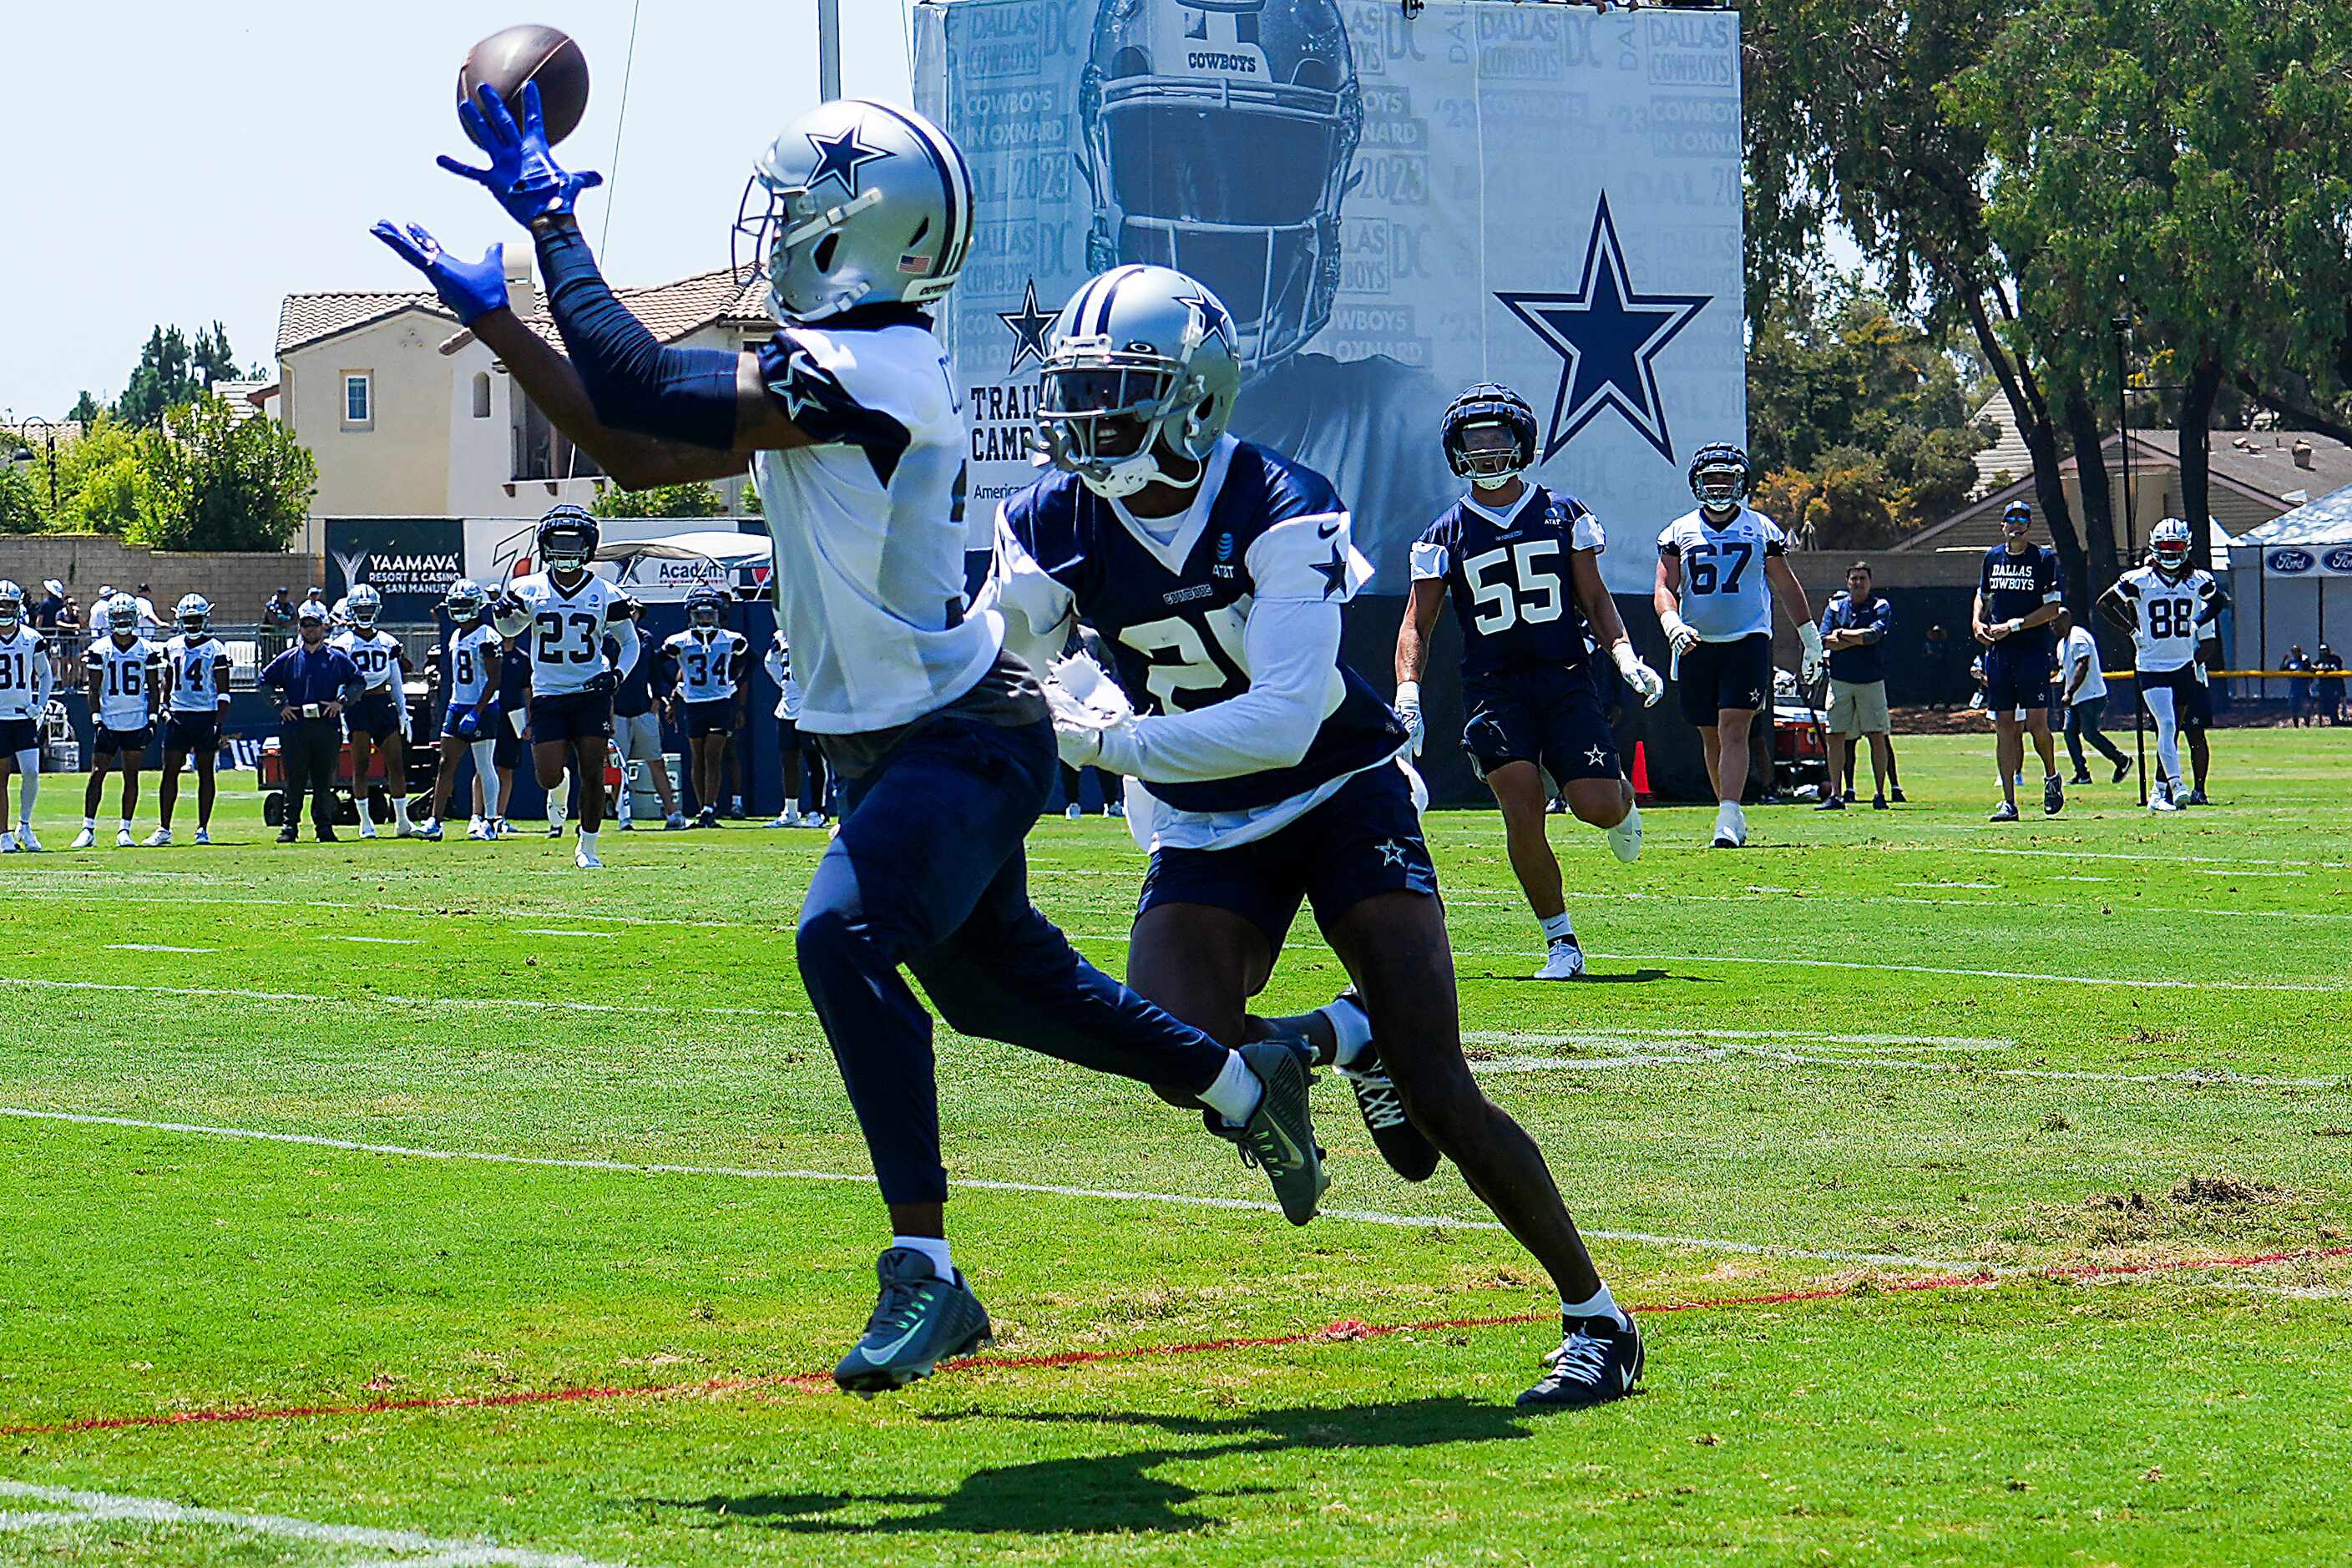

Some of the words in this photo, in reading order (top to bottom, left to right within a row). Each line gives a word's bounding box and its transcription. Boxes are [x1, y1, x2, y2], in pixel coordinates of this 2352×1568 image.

[972, 5, 1040, 39] DALLAS
[1480, 11, 1559, 43] DALLAS
[1650, 18, 1730, 49] DALLAS
[1563, 12, 1603, 68] DC
[969, 42, 1037, 74] COWBOYS
[1188, 52, 1257, 73] COWBOYS
[1482, 45, 1559, 77] COWBOYS
[1651, 53, 1730, 83] COWBOYS
[967, 89, 1053, 117] COWBOYS
[965, 124, 985, 148] IN
[989, 119, 1065, 145] OXNARD
[1013, 156, 1070, 200] 2023
[972, 427, 1034, 462] CAMP
[368, 573, 409, 582] RESORT
[411, 572, 419, 582] &
[421, 572, 461, 582] CASINO
[1212, 564, 1235, 579] AT&T
[1687, 542, 1753, 595] 67
[1991, 564, 2033, 577] DALLAS
[2276, 553, 2306, 569] Ford
[385, 584, 407, 594] SAN
[408, 584, 450, 594] MANUE
[1162, 584, 1213, 604] COWBOYS
[1463, 539, 1563, 635] 55
[1989, 577, 2035, 591] COWBOYS
[2148, 598, 2193, 640] 88
[535, 612, 597, 664] 23
[108, 660, 141, 695] 16
[173, 655, 204, 692] 14
[687, 654, 728, 686] 34
